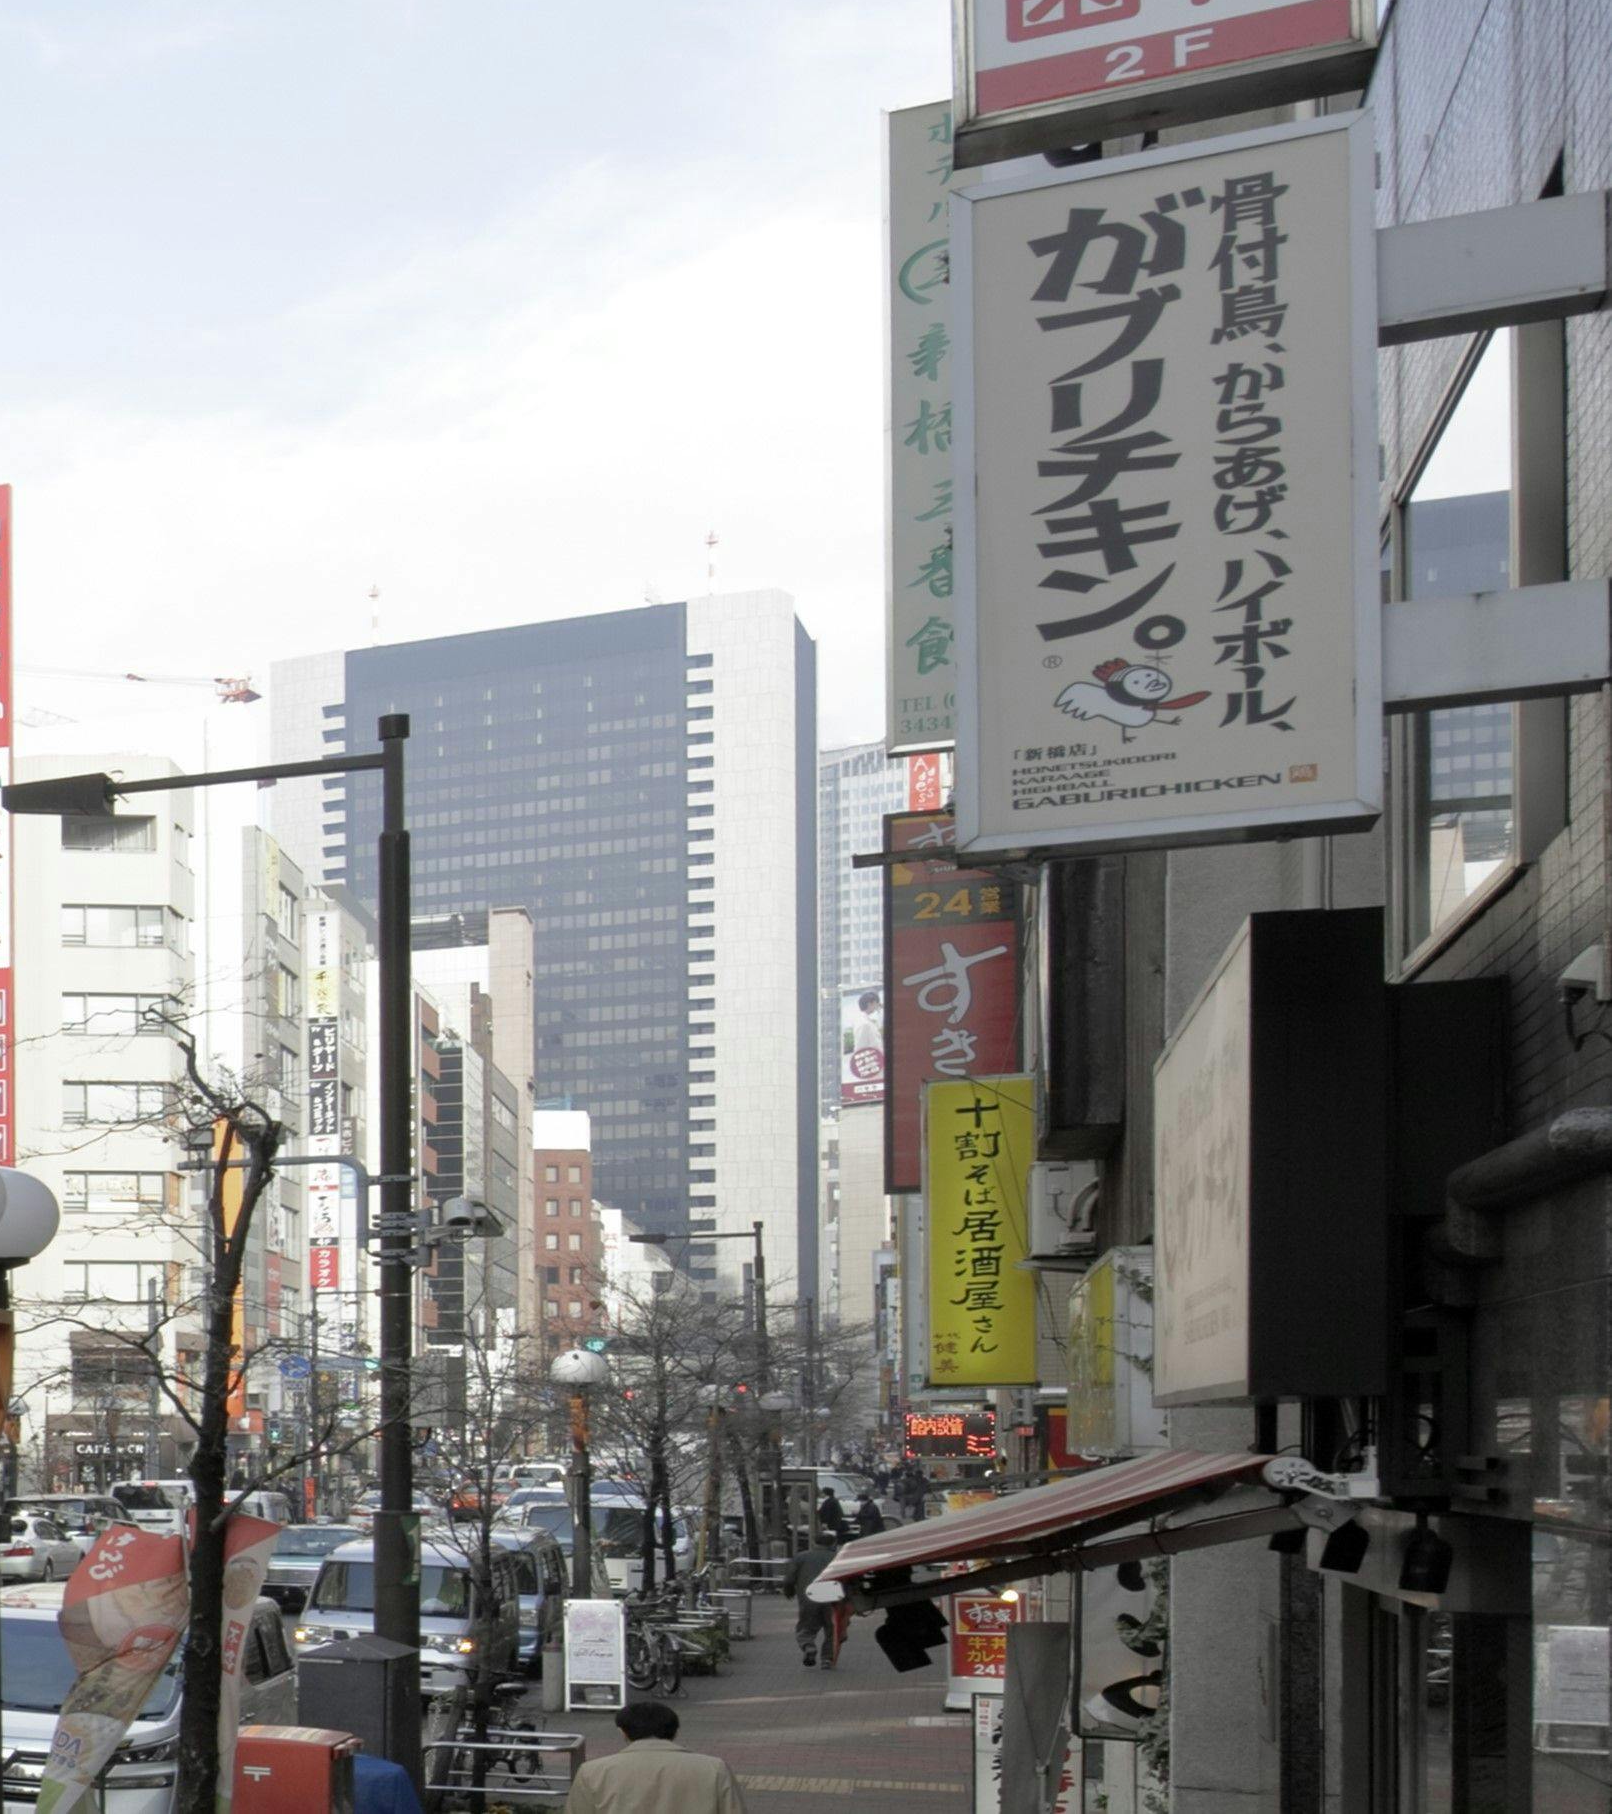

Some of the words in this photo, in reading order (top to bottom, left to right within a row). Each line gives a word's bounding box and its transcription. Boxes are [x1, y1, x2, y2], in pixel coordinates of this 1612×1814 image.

[1104, 28, 1214, 83] 2F
[1027, 185, 1205, 651] がブリチキン。
[1209, 170, 1297, 732] 骨付鳥、からあげ、ハイボール、
[898, 696, 934, 714] TEL
[1012, 751, 1177, 777] HONETSUKIDORI
[1014, 742, 1098, 762] 「新橋店」
[1011, 780, 1115, 797] HIGHBALL
[1012, 768, 1112, 786] KARAAGE
[1012, 772, 1283, 811] GABURICHICKEN
[913, 888, 973, 921] 24
[902, 941, 1009, 1077] すき
[324, 1026, 336, 1073] ビリヤード
[324, 1081, 336, 1133] インターネット
[950, 1097, 1006, 1354] 十割そば居酒屋さん
[317, 1249, 332, 1287] カラオケ
[964, 1602, 1012, 1625] すき家
